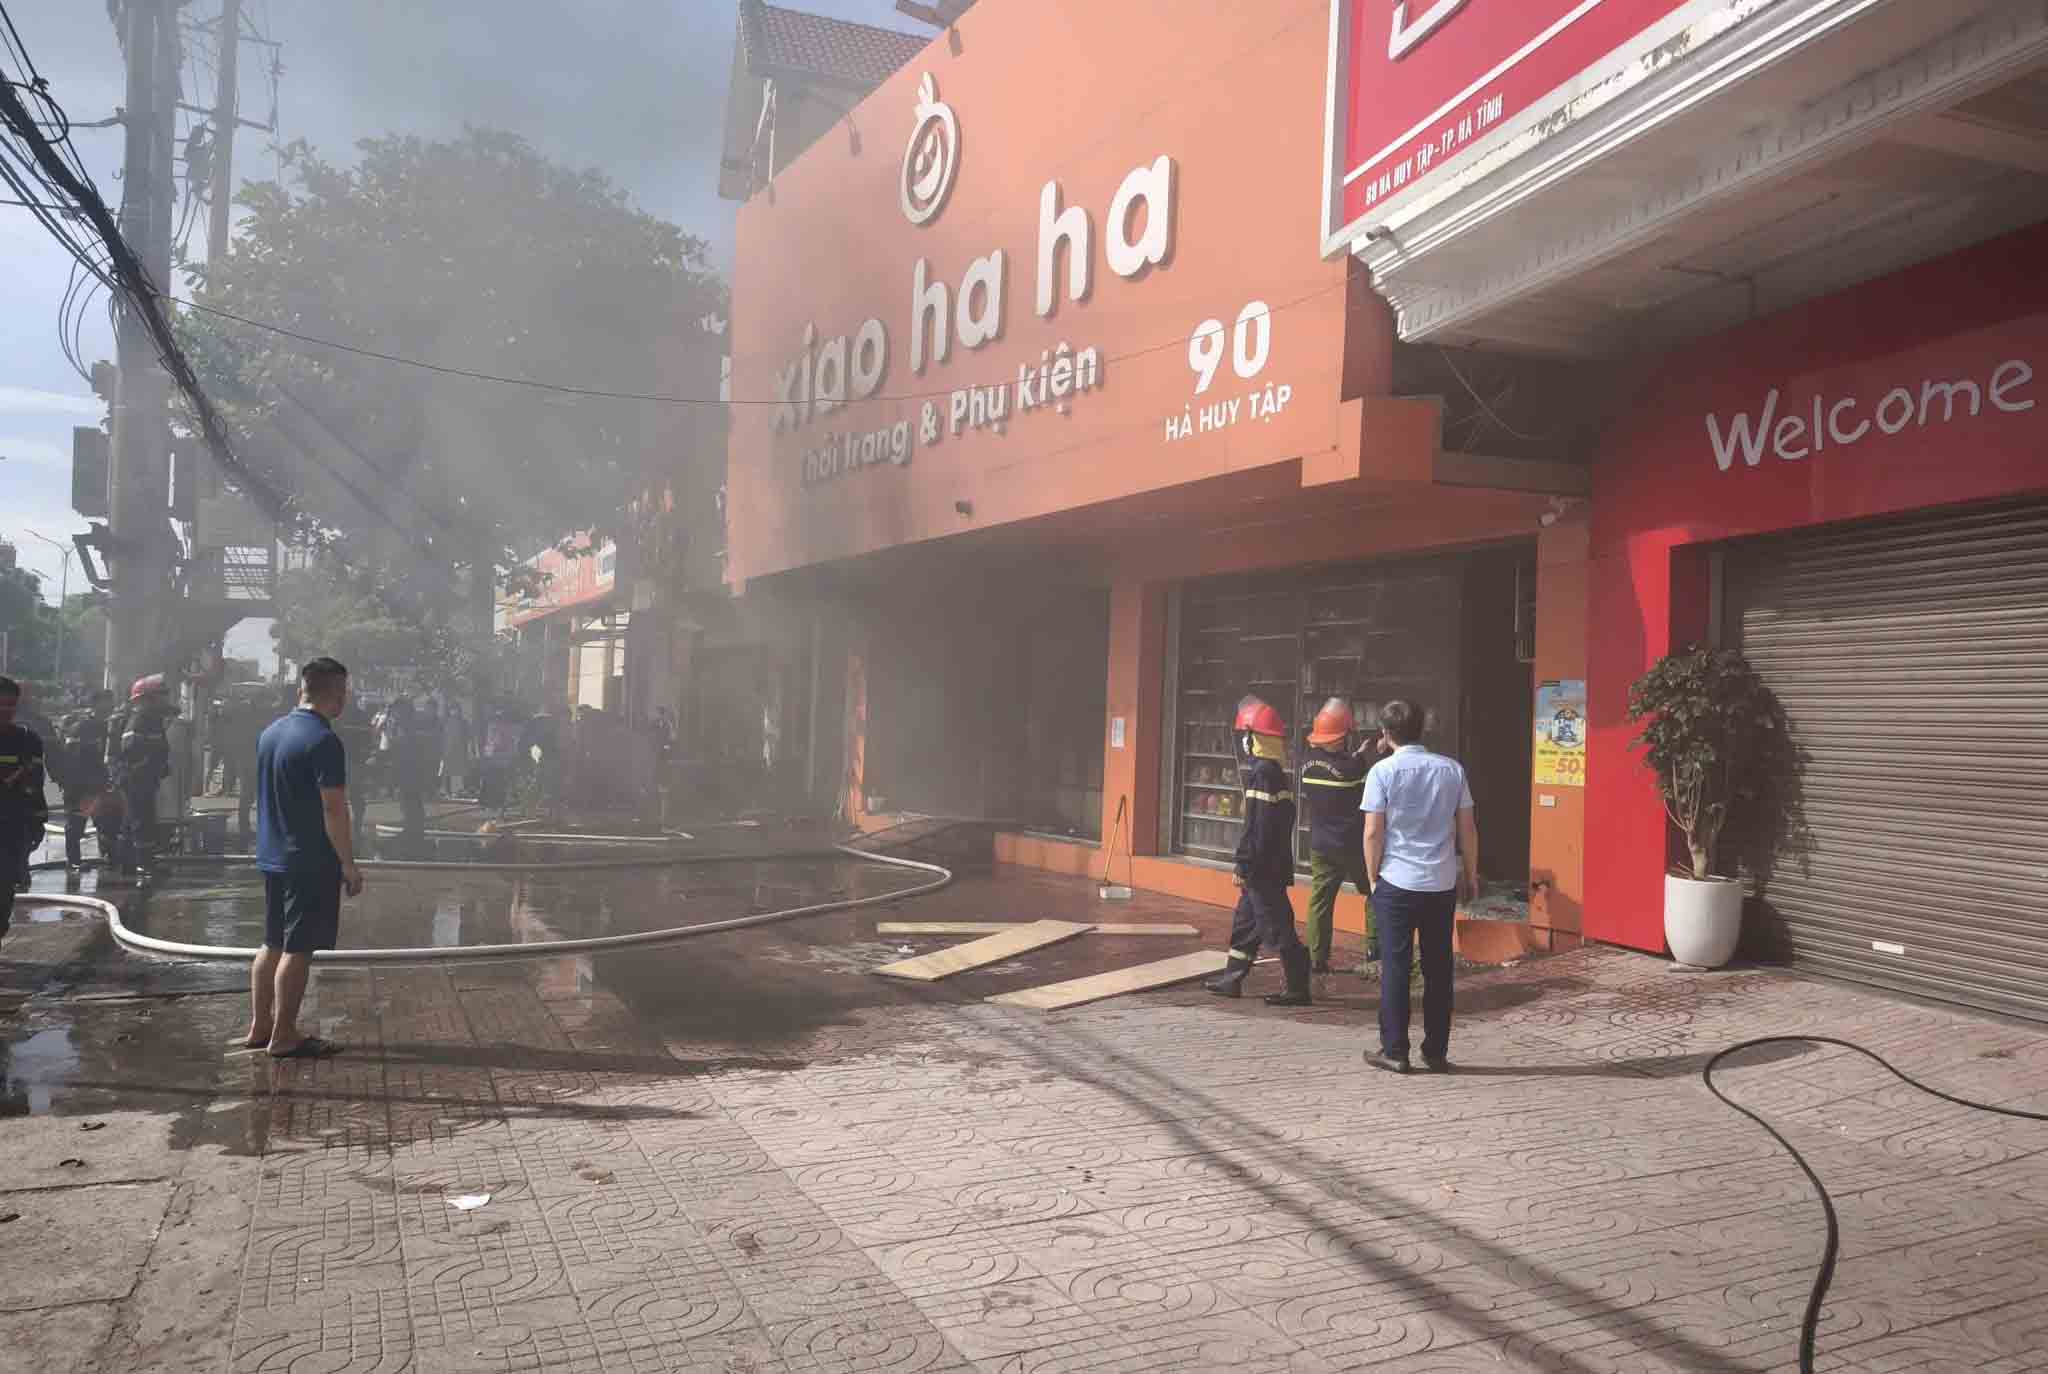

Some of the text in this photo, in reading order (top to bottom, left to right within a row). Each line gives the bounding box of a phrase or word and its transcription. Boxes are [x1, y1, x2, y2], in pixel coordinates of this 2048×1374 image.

[770, 154, 1171, 432] xiao ha ha
[918, 400, 939, 442] &
[950, 384, 1006, 434] Phụ
[1018, 340, 1098, 414] kiện
[1188, 300, 1271, 395] 90
[1165, 381, 1292, 442] HÀ HUY TẬP
[1705, 358, 2036, 471] Welcome
